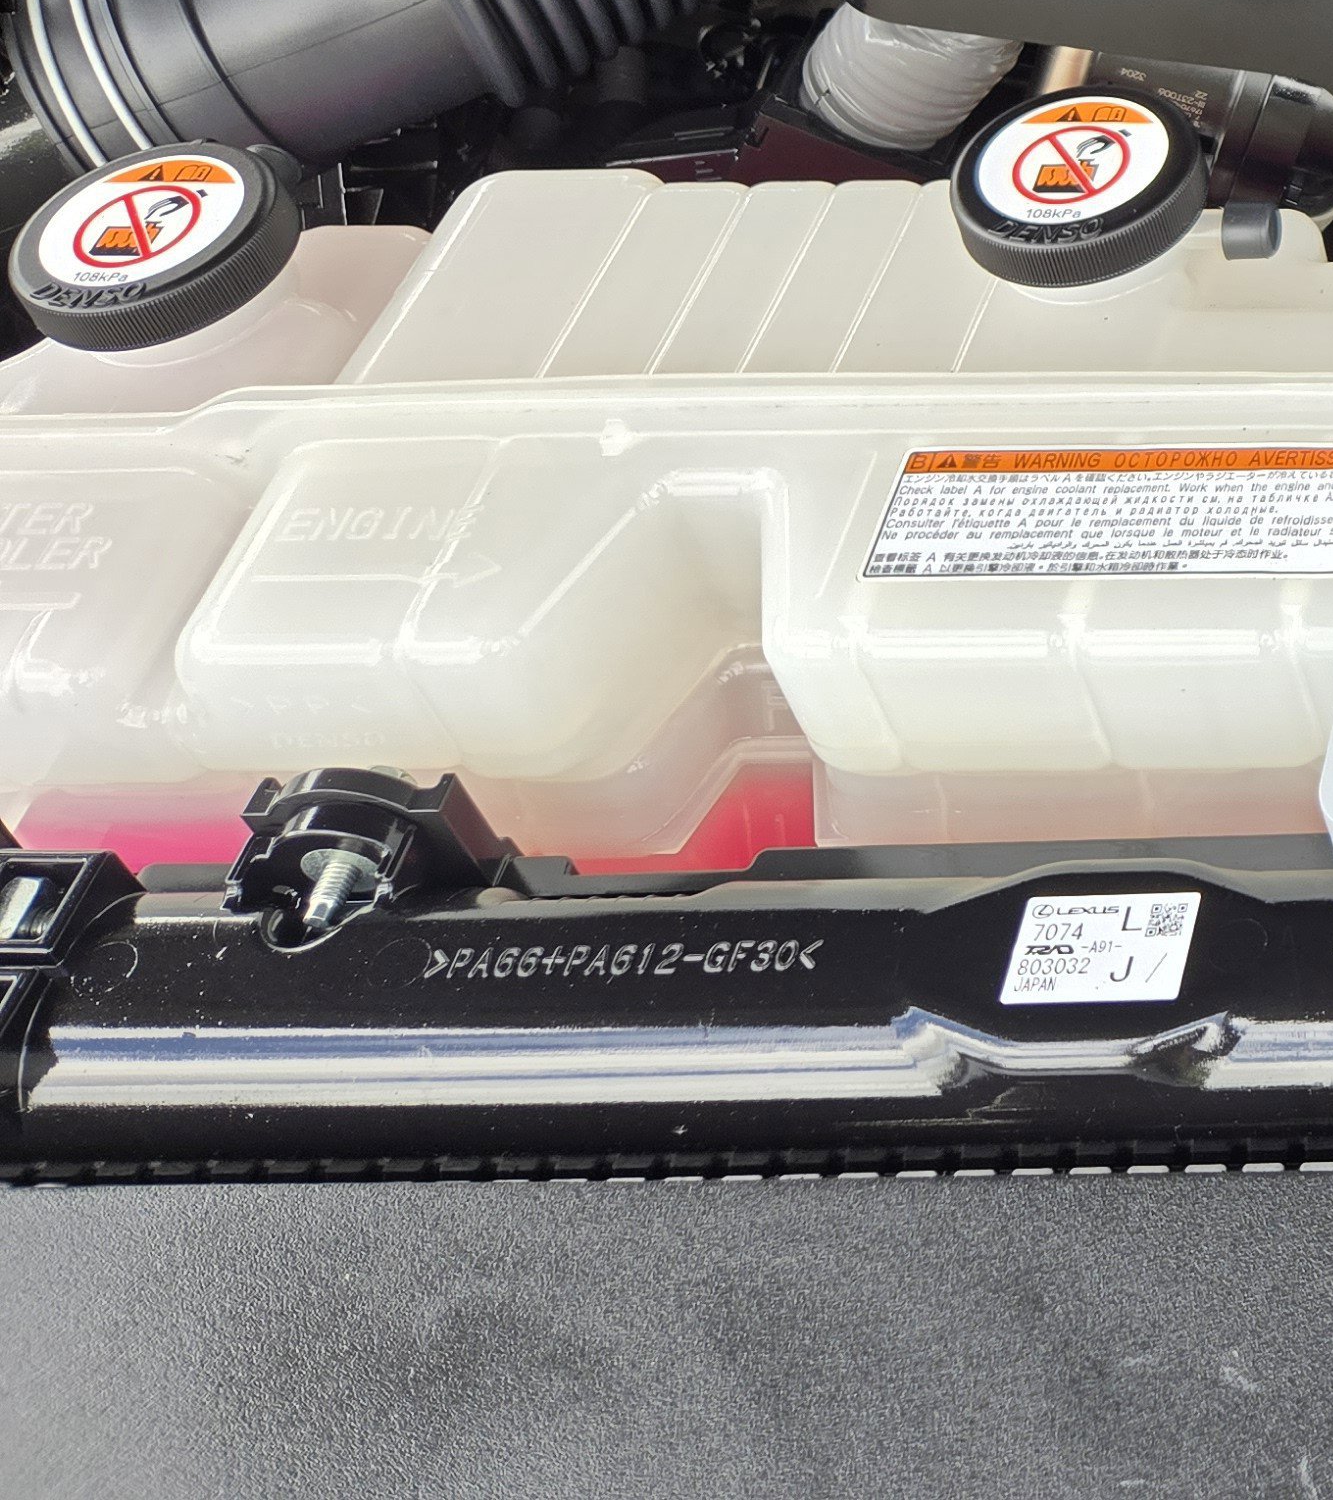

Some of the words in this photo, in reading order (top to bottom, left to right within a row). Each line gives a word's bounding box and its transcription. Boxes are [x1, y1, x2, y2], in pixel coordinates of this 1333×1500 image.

[1025, 208, 1082, 219] 108kPa
[988, 217, 1104, 244] DENSO
[73, 271, 129, 283] 108kPa
[29, 282, 147, 310] DENSO
[910, 455, 926, 469] B
[961, 454, 1000, 468] 警告
[1014, 452, 1101, 469] WARNING
[1114, 450, 1238, 469] ОСТОРОЖНО
[900, 486, 933, 494] Check
[940, 485, 968, 494] label
[973, 486, 982, 494] A
[990, 485, 1005, 494] for
[1012, 486, 1048, 496] engine
[1055, 484, 1096, 494] coolant
[1103, 484, 1170, 494] replacement.
[1179, 483, 1208, 492] Work
[1215, 483, 1243, 492] when
[1250, 482, 1267, 491] the
[1275, 482, 1310, 492] engine
[275, 504, 486, 543] ENGINE
[886, 518, 945, 528] Consulter
[1018, 518, 1027, 527] A
[1035, 518, 1064, 528] pour
[1071, 518, 1081, 527] le
[1089, 517, 1171, 528] remplacement
[1179, 516, 1194, 526] du
[1202, 516, 1242, 526] liquide
[1250, 515, 1263, 525] de
[881, 531, 897, 539] Ne
[966, 531, 982, 539] au
[989, 529, 1072, 540] remplacement
[1081, 530, 1103, 539] que
[1111, 528, 1155, 538] lorsque
[1163, 528, 1173, 537] le
[1181, 528, 1223, 537] moteur
[1231, 527, 1241, 536] et
[1250, 527, 1260, 536] le
[1268, 526, 1322, 536] radiateur
[0, 536, 113, 571] LER
[1056, 905, 1120, 915] LEXUS
[1121, 906, 1142, 932] L
[1033, 923, 1084, 941] 7074
[424, 939, 825, 979] >PA66+PA612-GF30<
[1017, 957, 1091, 975] 803032
[1013, 976, 1057, 992] JAPAN
[1109, 955, 1134, 982] J
